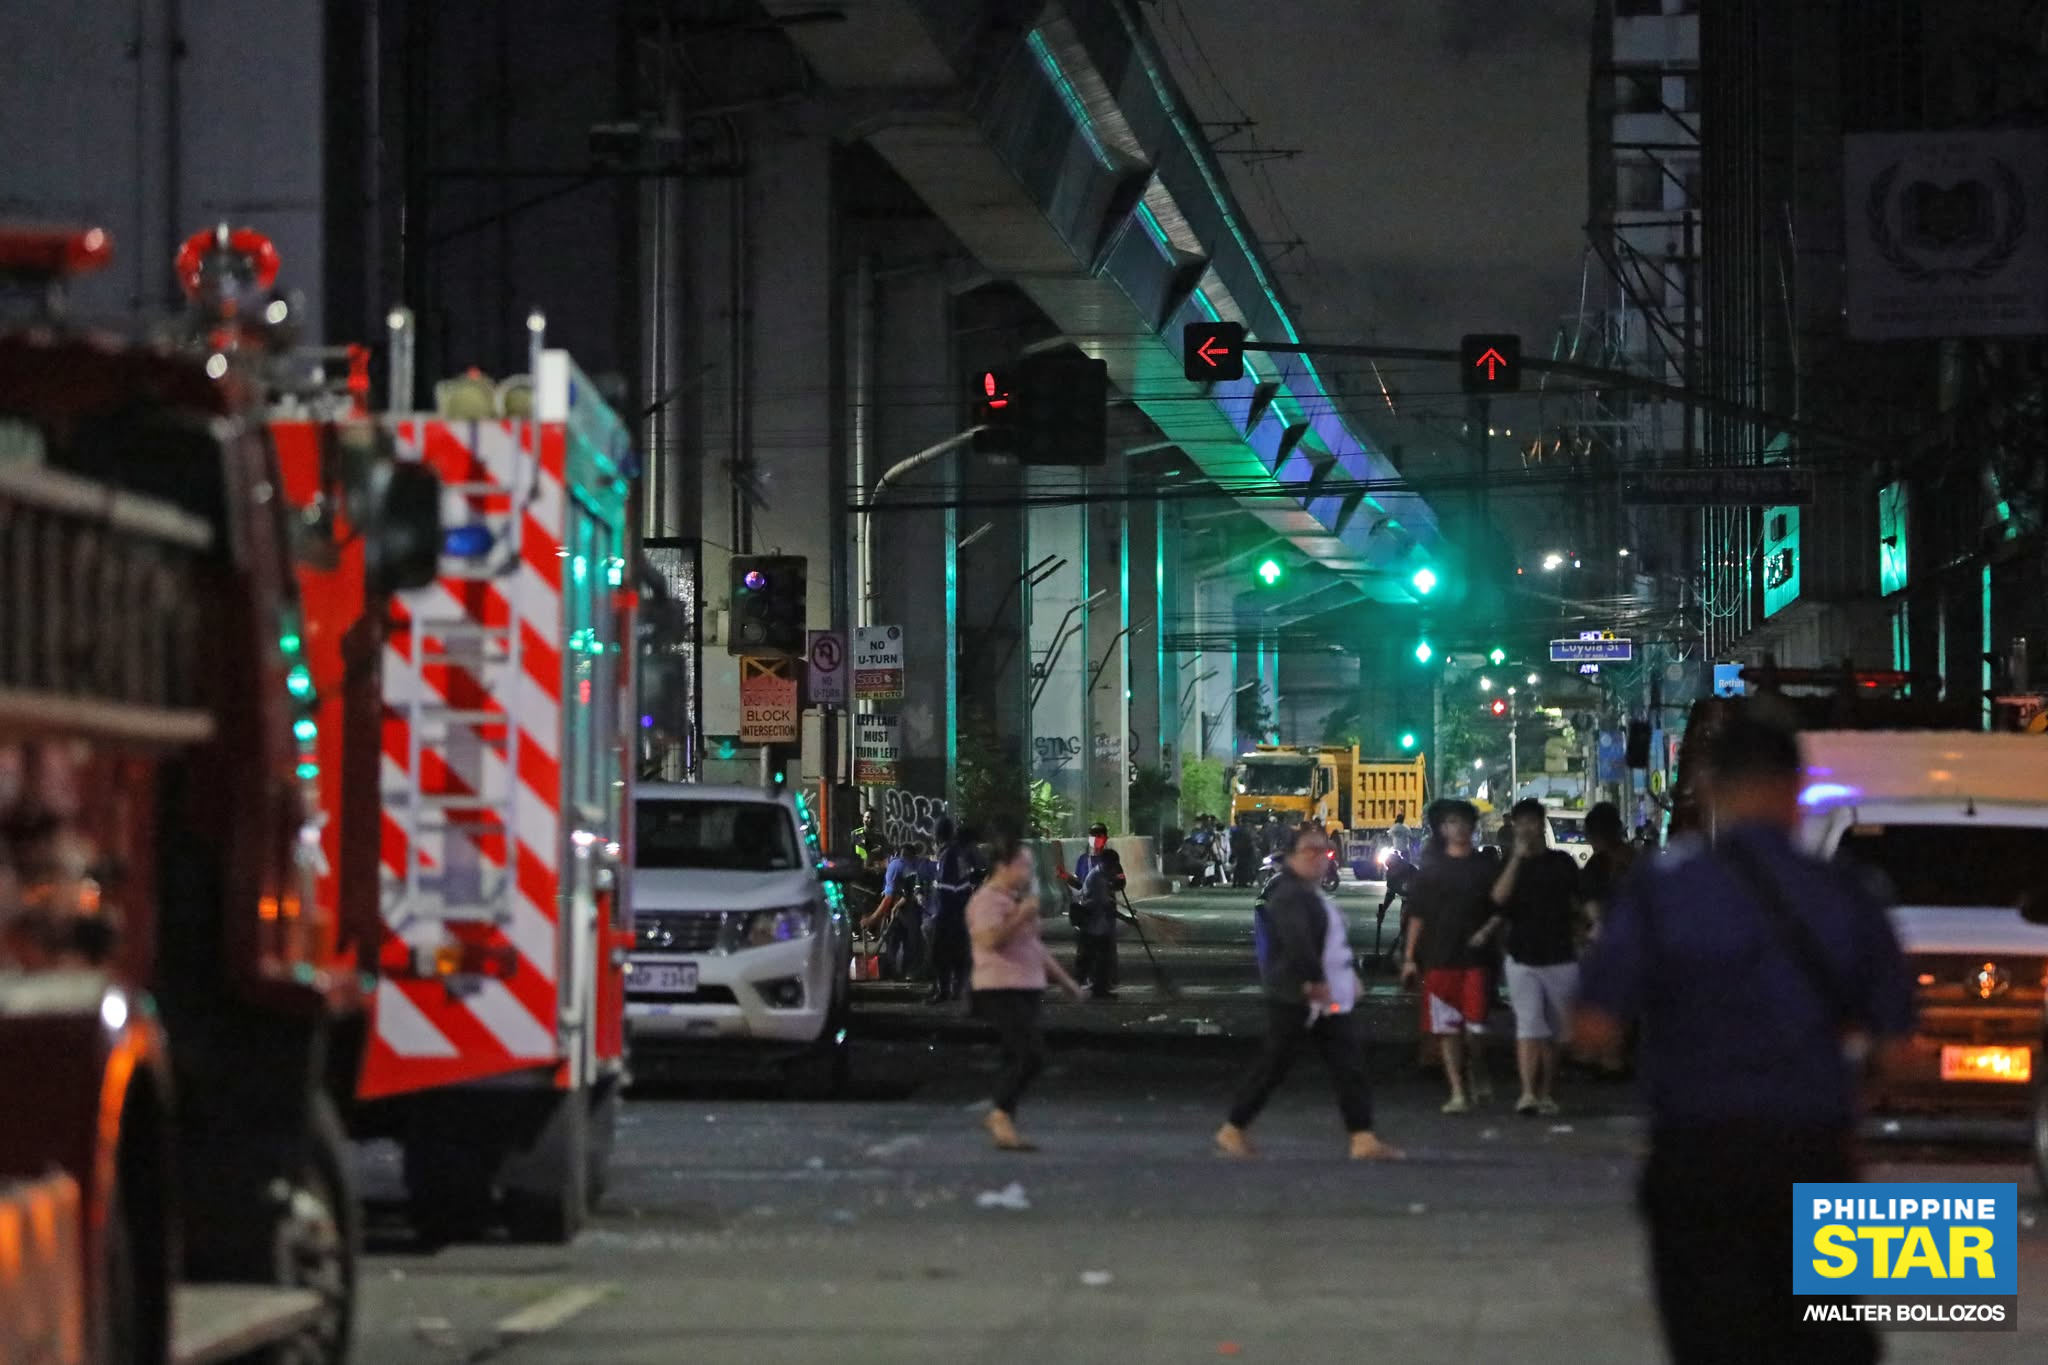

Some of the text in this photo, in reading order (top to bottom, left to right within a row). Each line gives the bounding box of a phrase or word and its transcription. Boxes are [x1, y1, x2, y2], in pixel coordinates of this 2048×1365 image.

[870, 641, 885, 650] NO
[858, 654, 898, 664] U-TURN
[1580, 664, 1599, 673] ATM
[822, 676, 833, 686] NO
[814, 689, 840, 698] U-TURN
[746, 709, 790, 721] BLOCK
[857, 714, 898, 727] LEFT LANE
[742, 725, 795, 737] INTERSECTION
[864, 731, 888, 743] MUST
[856, 747, 898, 759] TURN LEFT
